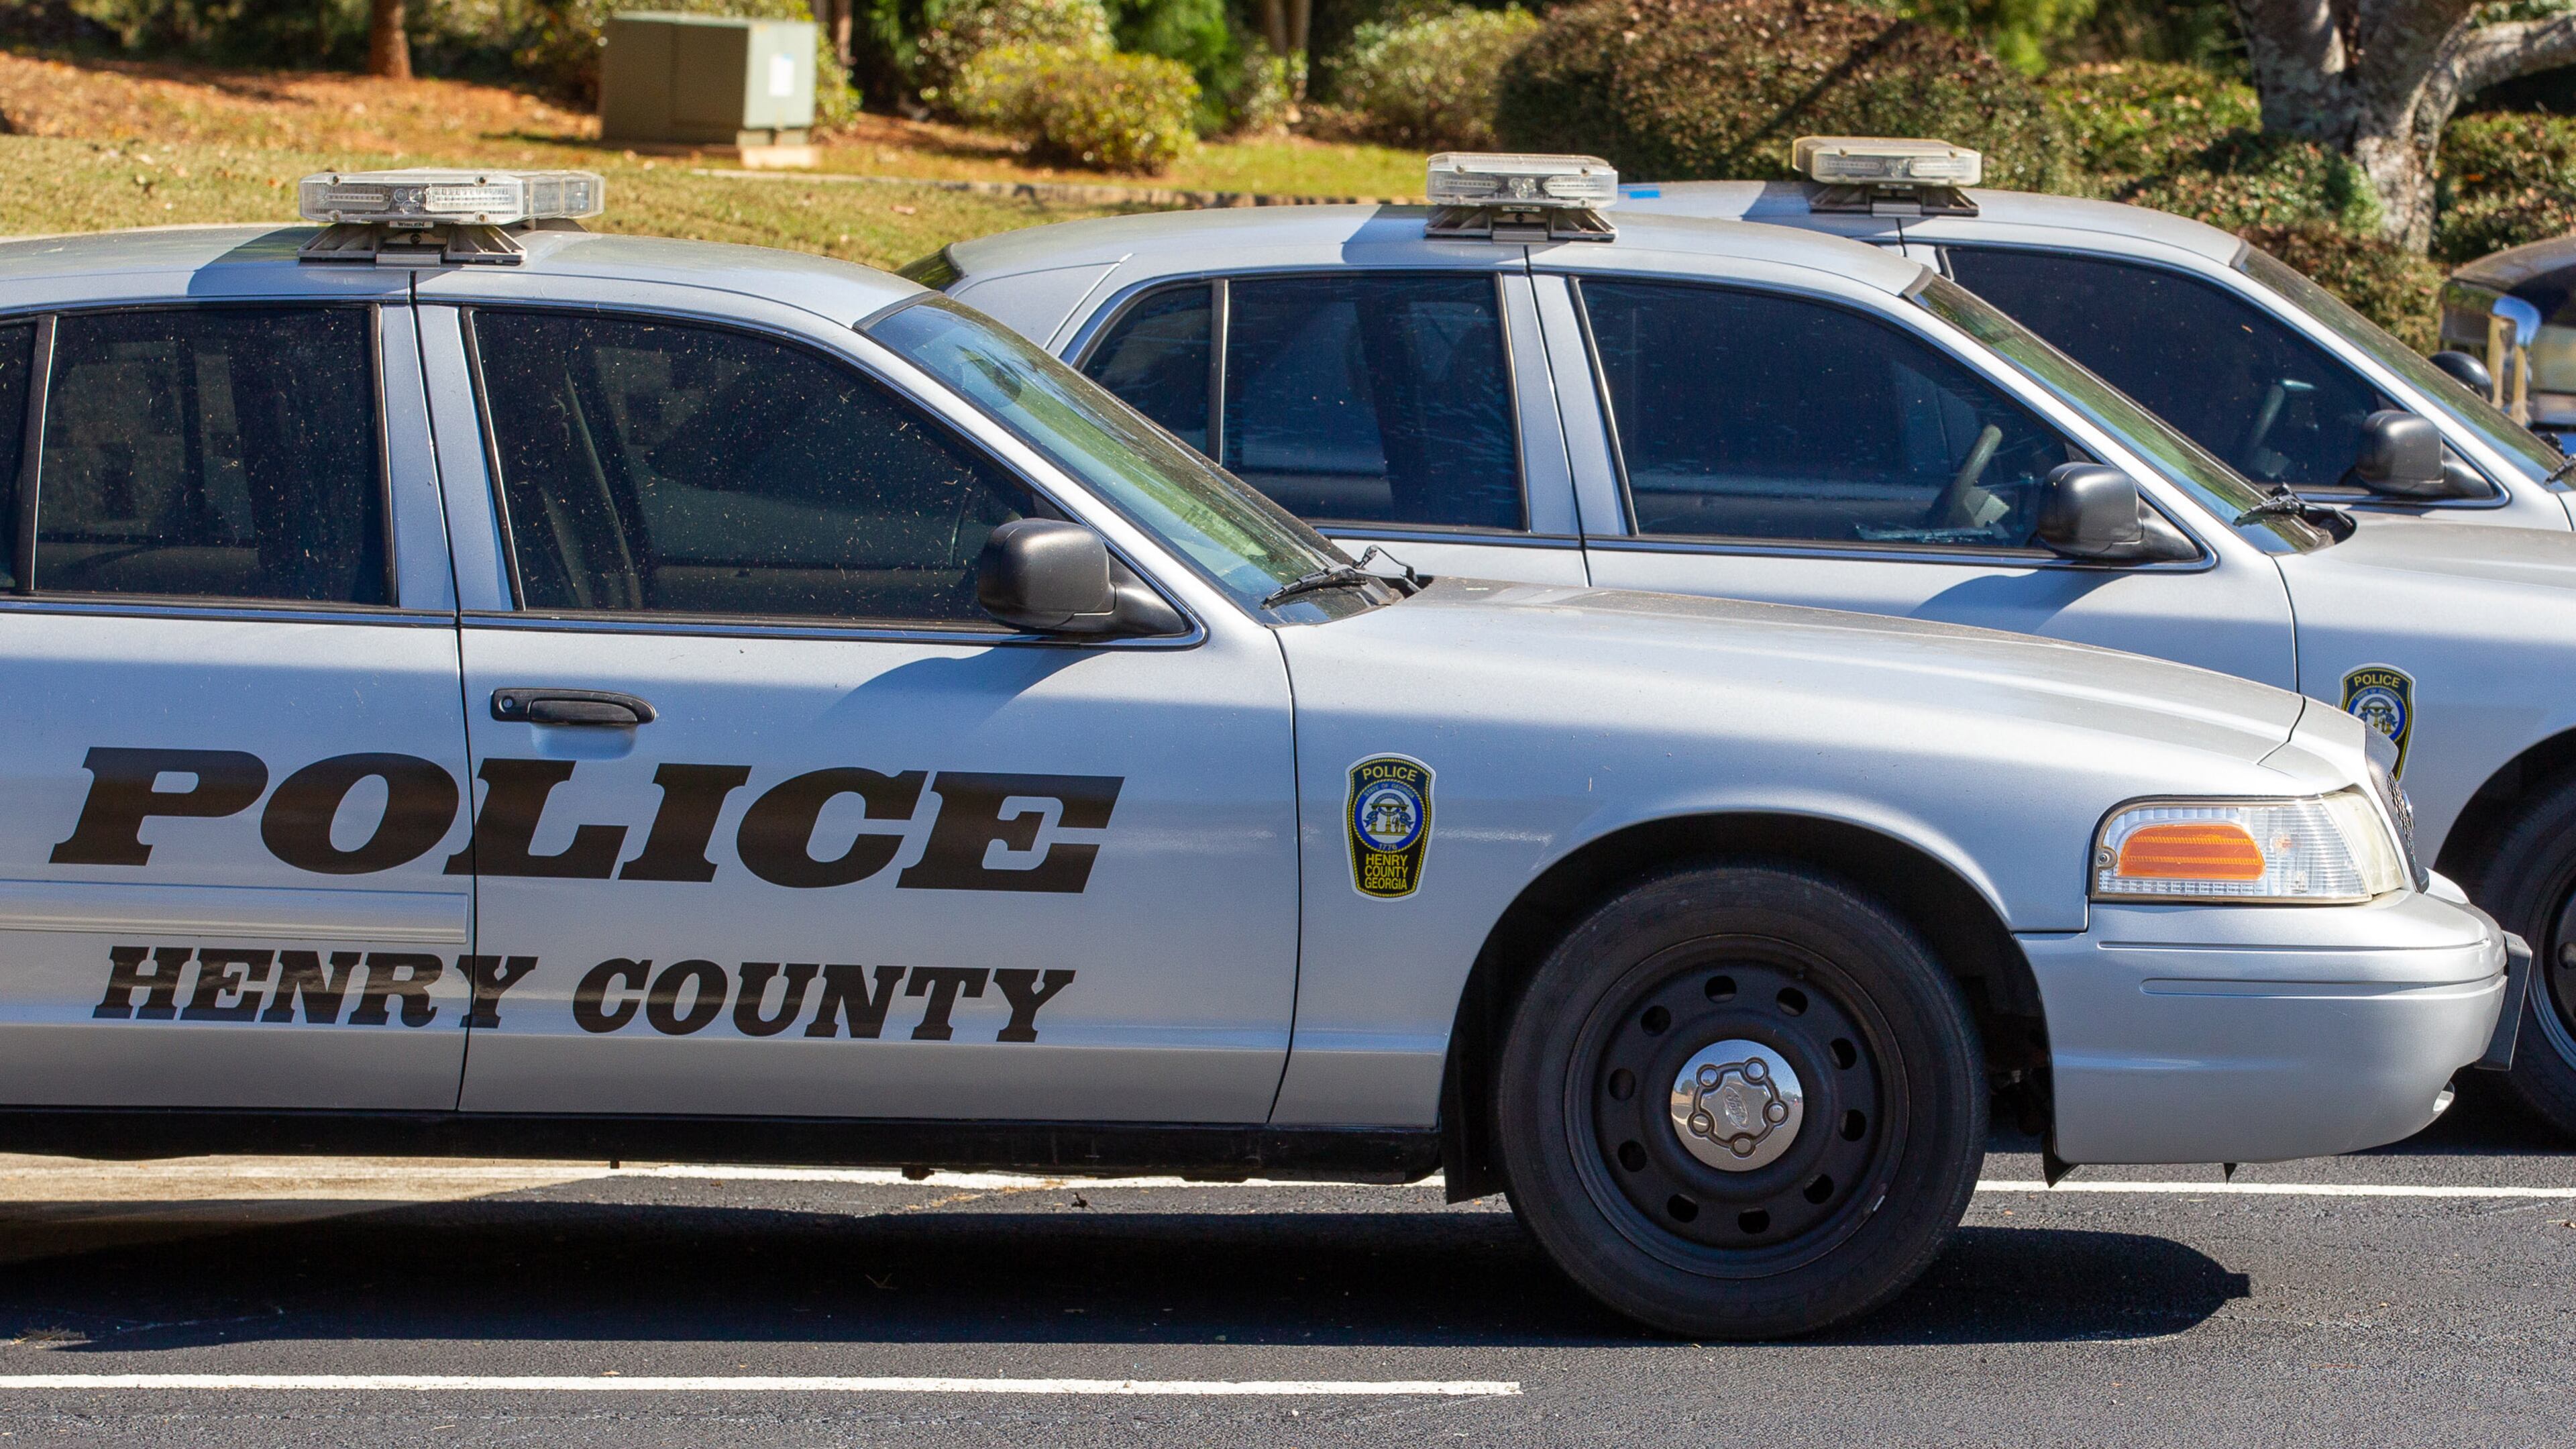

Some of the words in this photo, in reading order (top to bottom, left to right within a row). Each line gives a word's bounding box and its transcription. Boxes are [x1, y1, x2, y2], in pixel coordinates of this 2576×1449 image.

[2354, 674, 2400, 688] POLICE
[1362, 765, 1417, 782] POLICE
[49, 747, 1125, 893] POLICE
[1366, 853, 1408, 866] HENRY
[1364, 865, 1409, 878] COUNTY
[1364, 877, 1407, 890] GEORGIA
[93, 947, 538, 1029] HENRY
[572, 959, 1076, 1043] COUNTY
